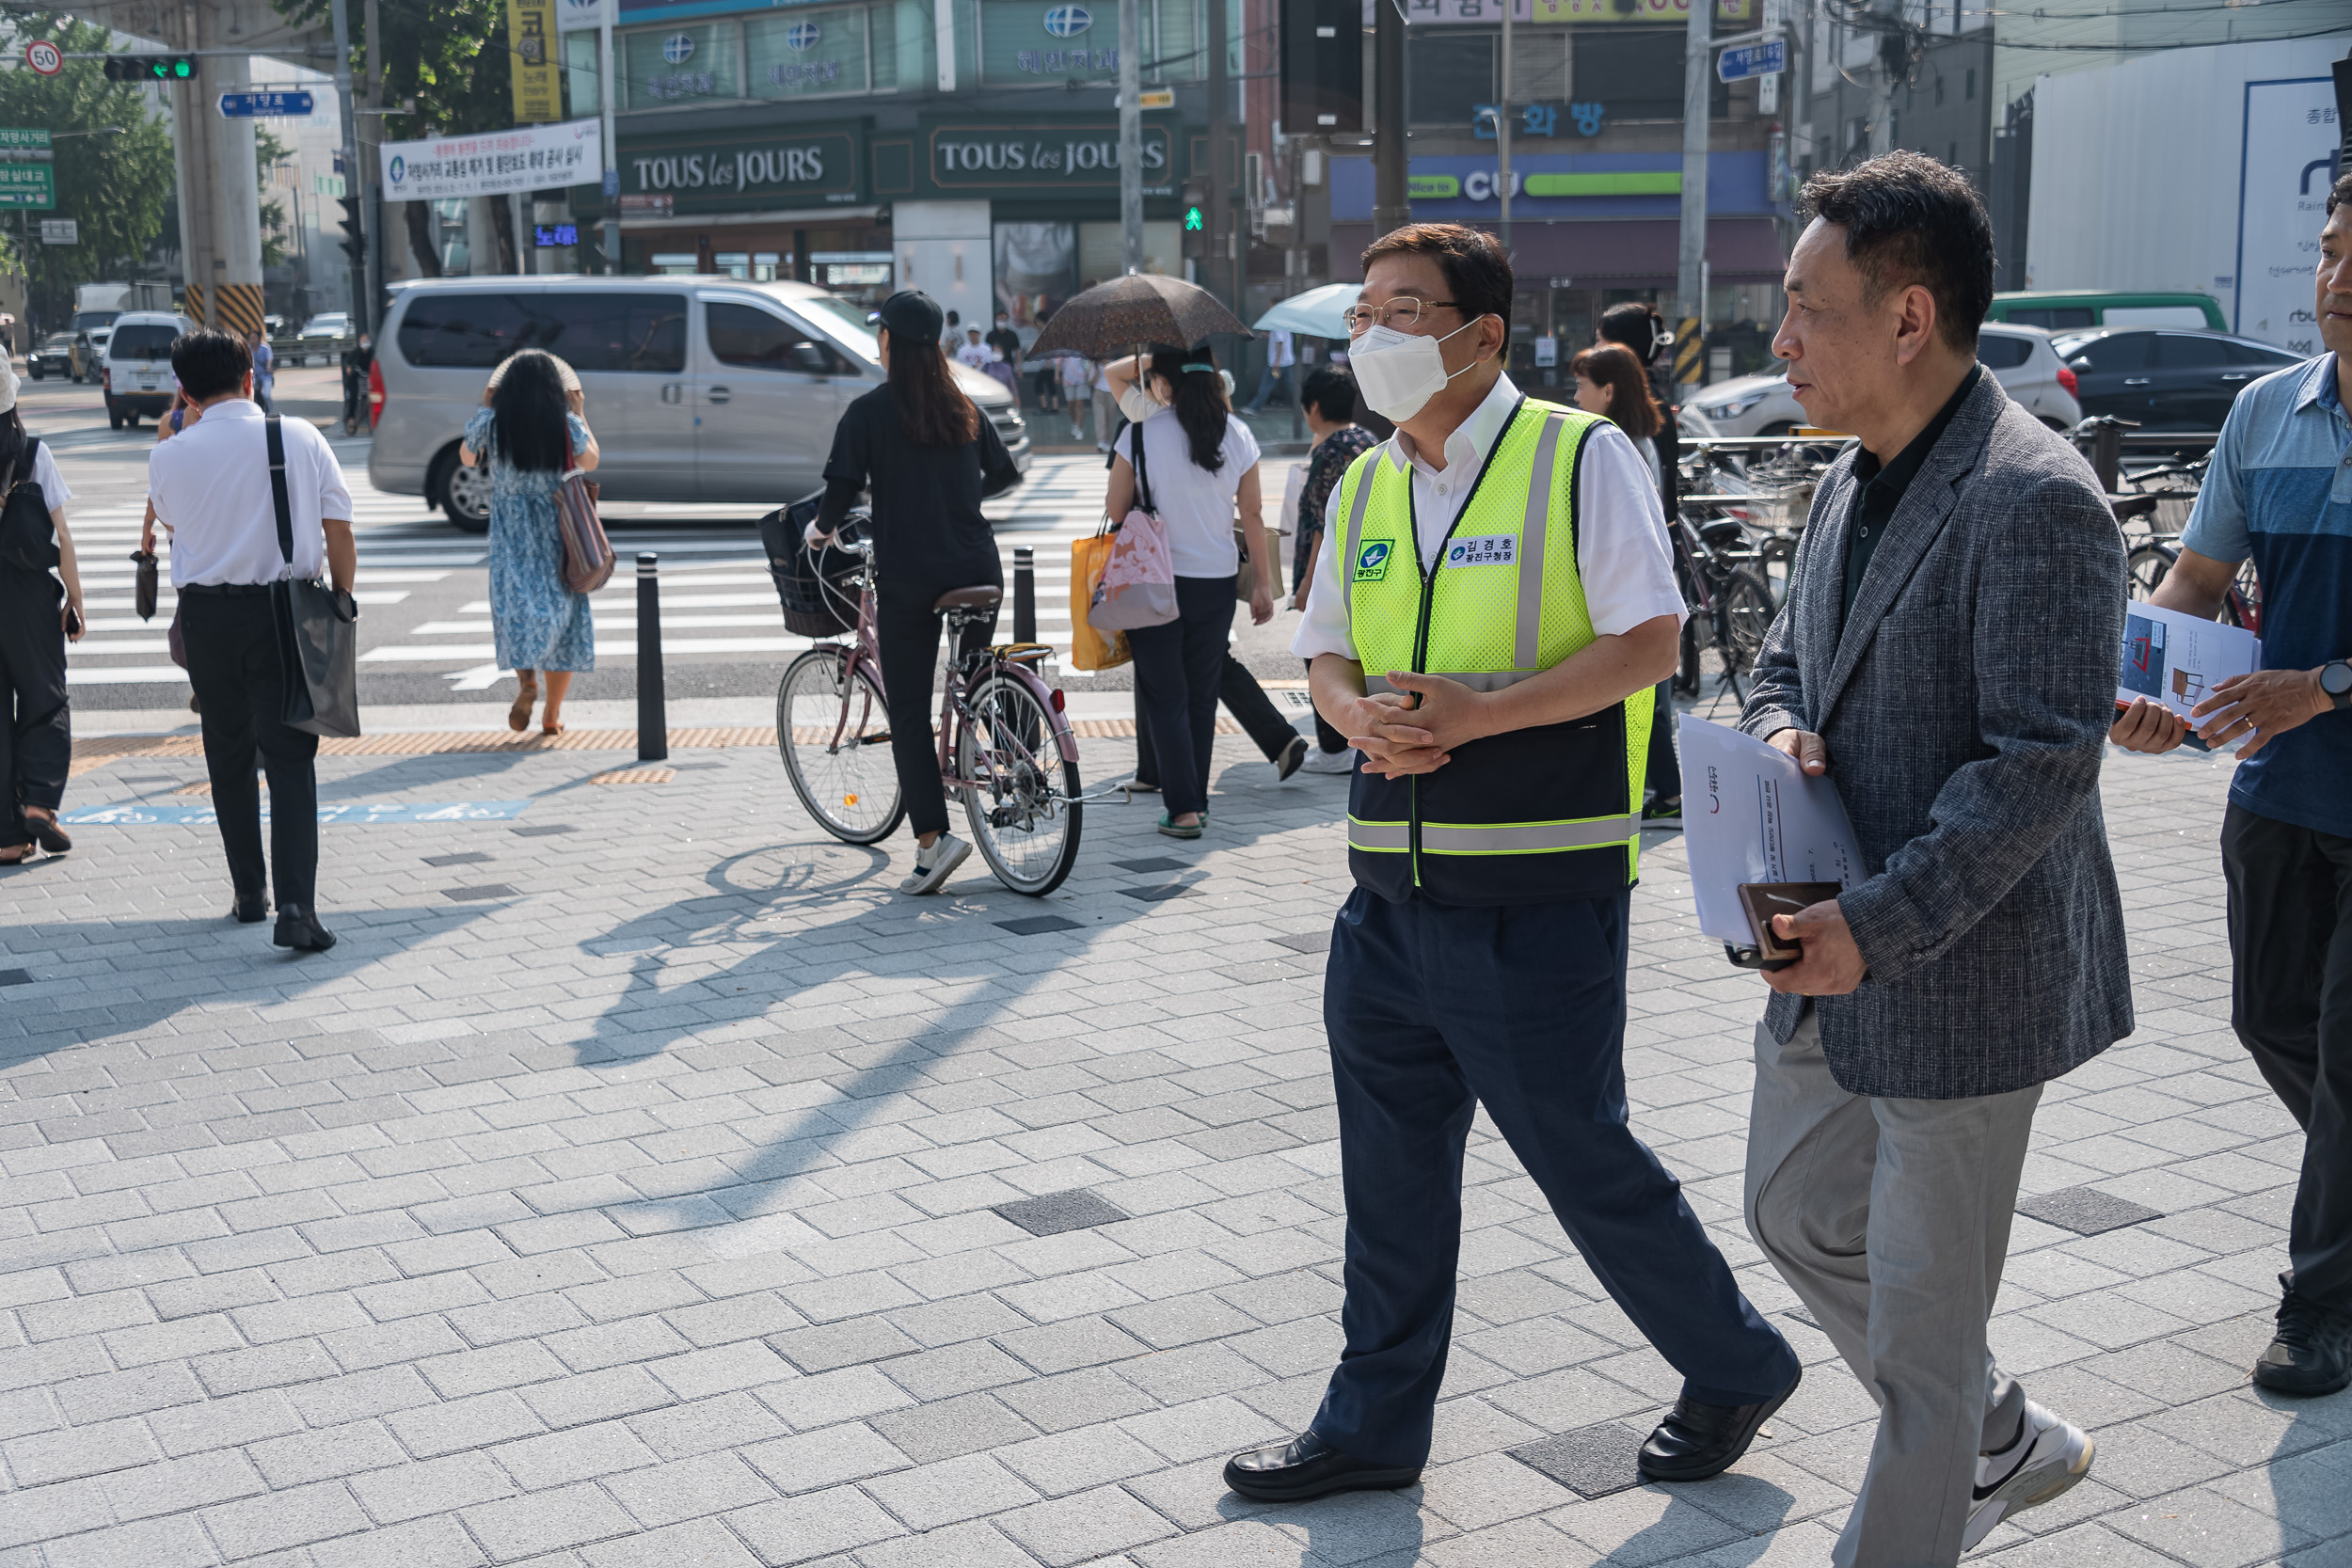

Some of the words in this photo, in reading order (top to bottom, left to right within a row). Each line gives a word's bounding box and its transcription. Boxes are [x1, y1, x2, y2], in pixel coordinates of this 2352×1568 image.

[34, 50, 56, 66] 50
[633, 153, 705, 190] TOUS
[708, 152, 735, 186] les
[736, 146, 824, 193] JOURS
[937, 142, 1026, 170] TOUS
[1031, 142, 1061, 169] les
[1064, 141, 1165, 177] JOUS
[1464, 169, 1520, 201] CU
[1466, 551, 1512, 563] 광진구청장
[1357, 568, 1382, 578] 광진구
